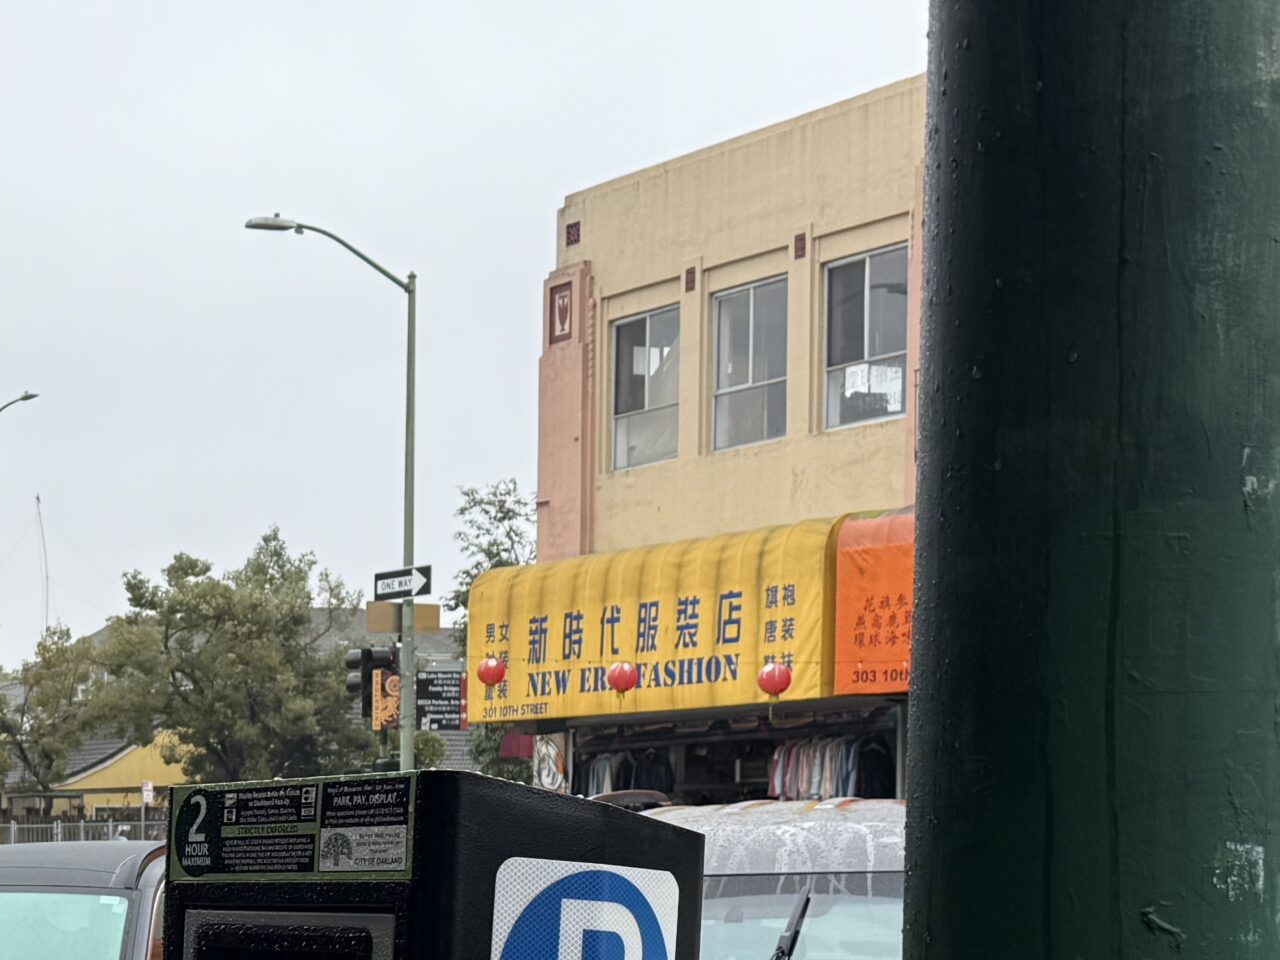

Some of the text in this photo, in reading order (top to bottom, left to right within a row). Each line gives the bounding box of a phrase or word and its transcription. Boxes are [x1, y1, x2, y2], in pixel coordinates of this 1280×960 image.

[381, 578, 412, 592] ONE WAY
[527, 590, 743, 666] 新時代服裝店
[526, 653, 740, 698] NEW ER FASHION
[852, 670, 877, 683] 303
[483, 702, 548, 718] 301 10TH STREET
[188, 794, 208, 842] 2
[237, 825, 298, 835] STRICTLY ENFORCED
[185, 843, 209, 856] HOUR
[182, 856, 211, 867] MAXIMUM
